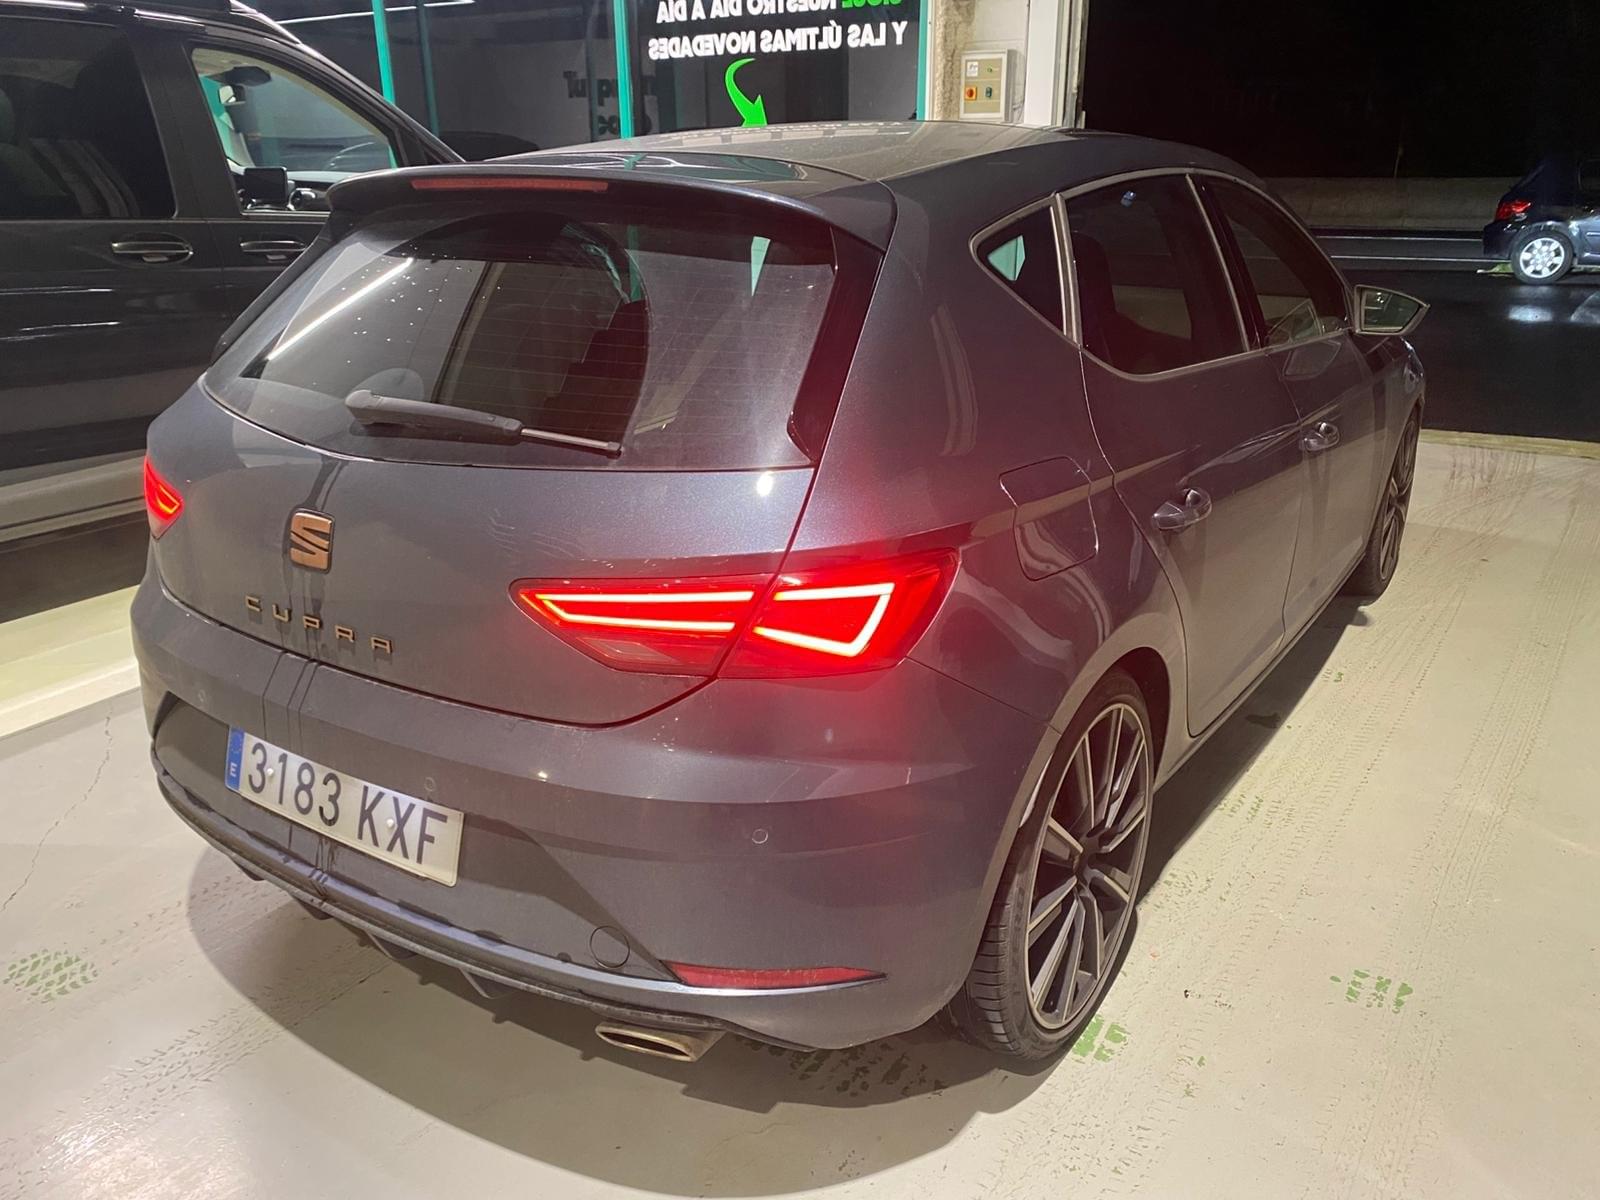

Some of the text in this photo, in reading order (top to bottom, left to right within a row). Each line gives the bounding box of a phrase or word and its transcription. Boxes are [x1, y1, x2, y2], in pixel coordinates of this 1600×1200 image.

[245, 595, 393, 654] CUPRA
[248, 742, 448, 864] 3183 KXF
